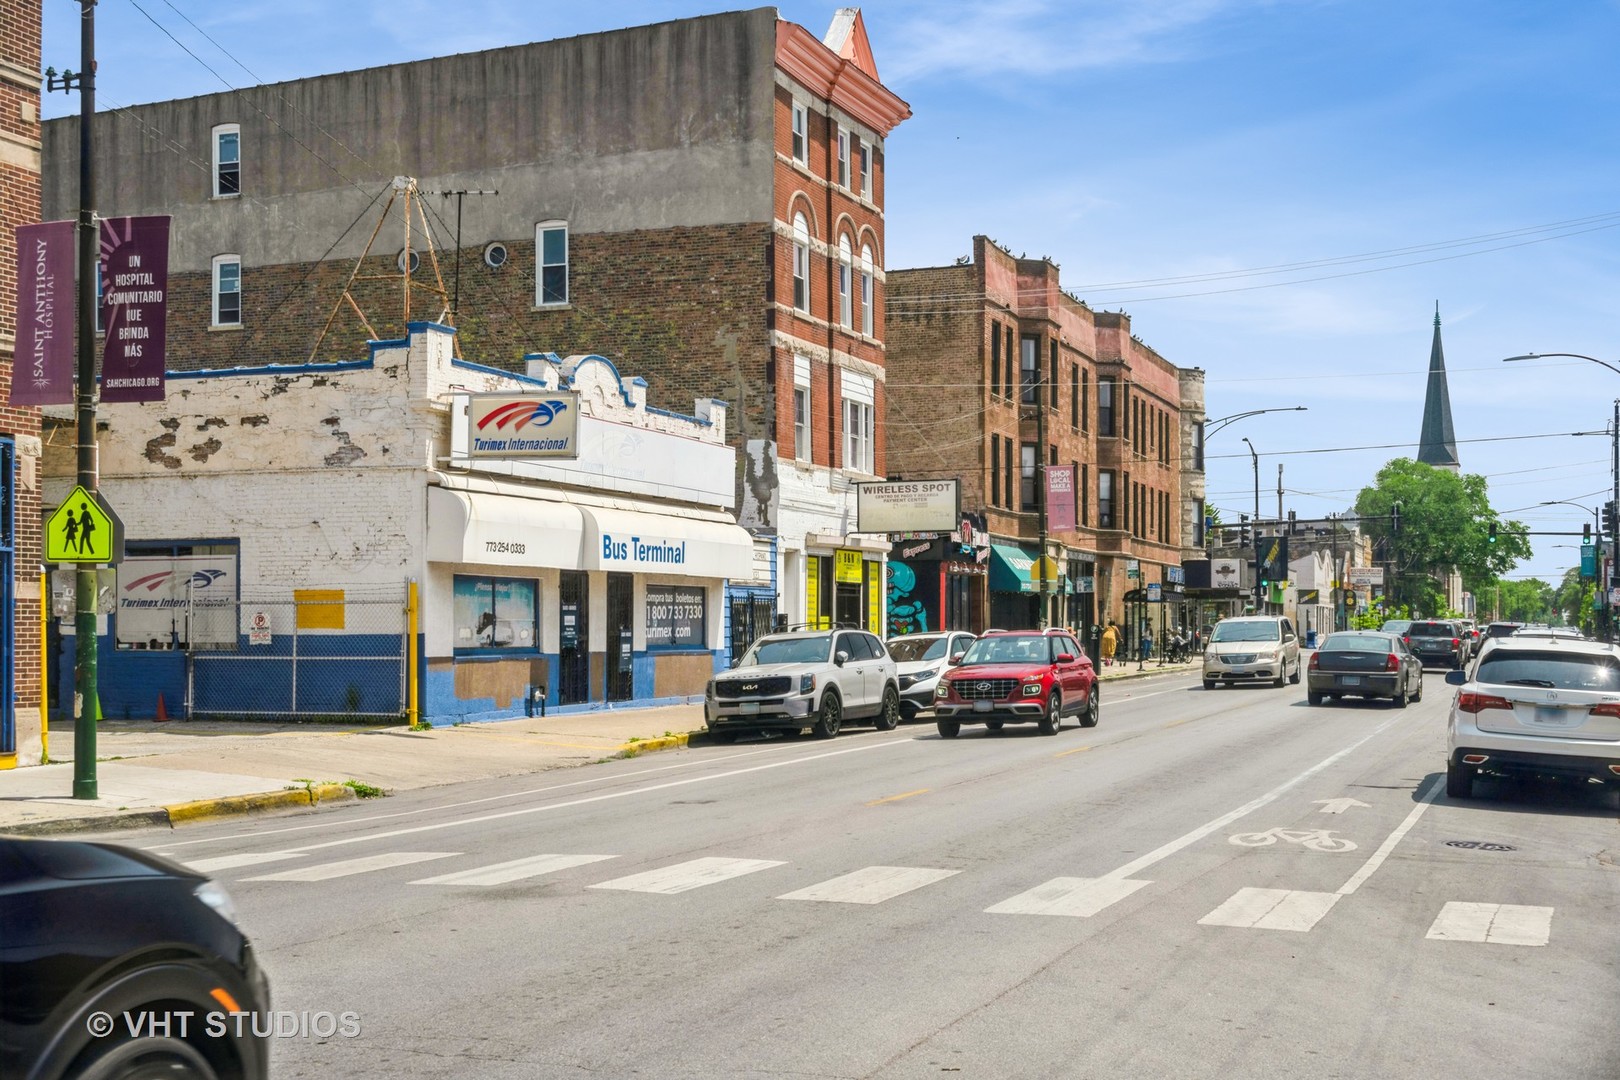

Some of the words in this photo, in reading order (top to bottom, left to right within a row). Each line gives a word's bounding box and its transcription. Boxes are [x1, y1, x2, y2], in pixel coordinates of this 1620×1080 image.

[128, 255, 141, 268] UN
[35, 239, 47, 324] ANTHONY
[115, 273, 155, 287] HOSPITAL
[107, 290, 163, 305] COMUNITARIO
[44, 274, 55, 339] HOSPITAL
[126, 309, 142, 322] QUE
[118, 326, 149, 340] BRINDA
[34, 328, 44, 378] SAINT
[124, 342, 143, 358] MÁS
[106, 377, 160, 388] SAHCHICAGO.ORG
[474, 437, 507, 451] Turimex
[508, 437, 569, 450] Internacional
[1050, 470, 1071, 478] SHOP
[863, 484, 919, 495] WIRELESS
[921, 483, 952, 493] SPOT
[603, 534, 628, 561] Bus
[631, 536, 685, 564] Terminal
[902, 541, 931, 559] Express
[121, 598, 159, 608] Turimex
[665, 593, 673, 602] tus
[652, 605, 667, 619] 800
[684, 605, 703, 619] 7330
